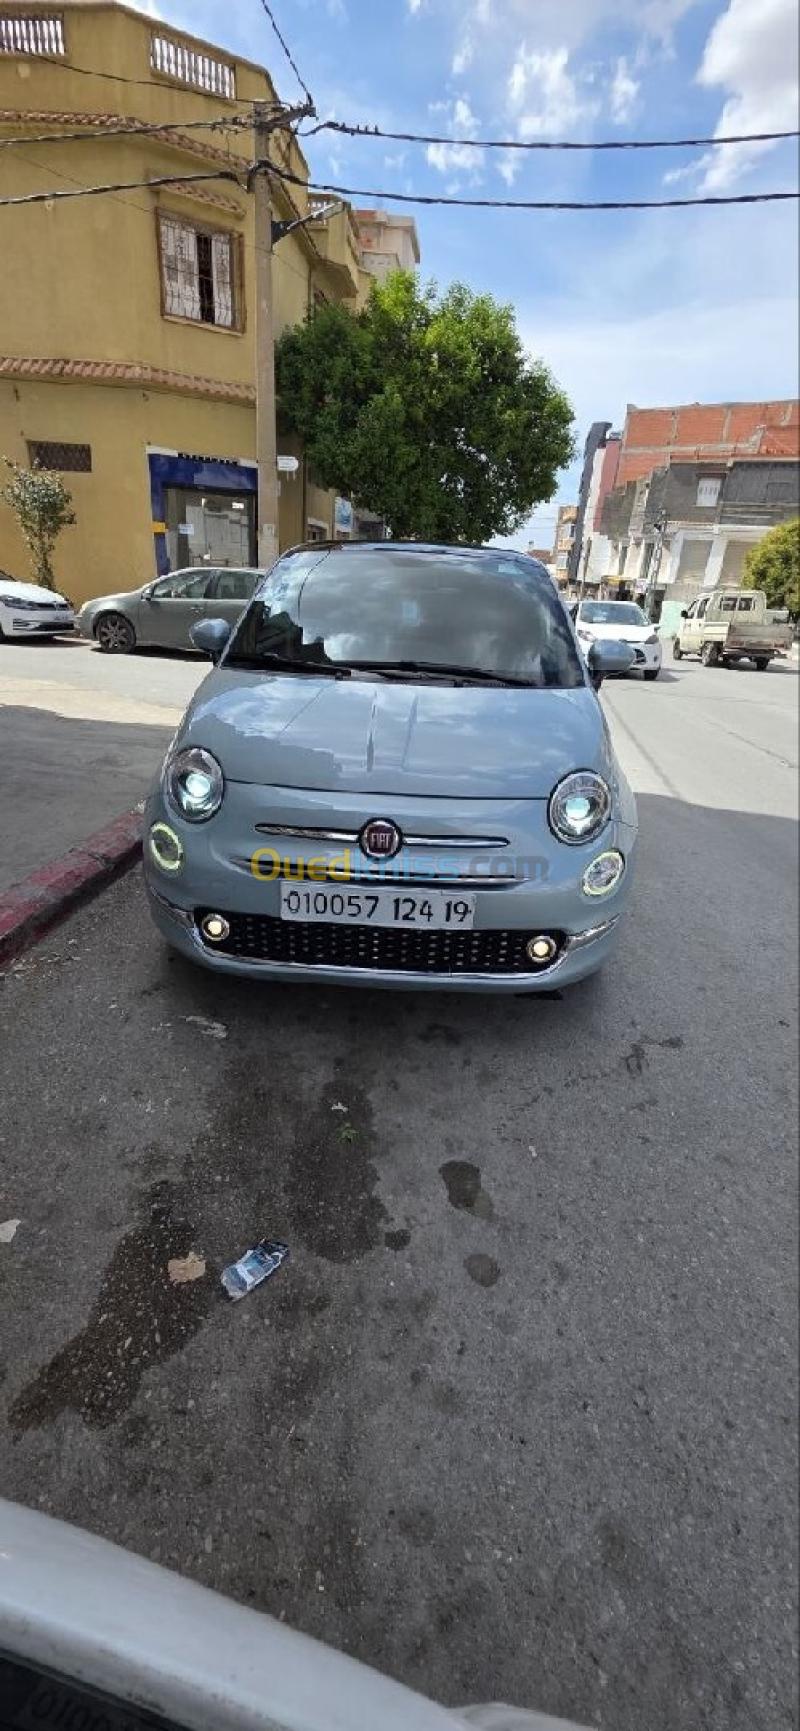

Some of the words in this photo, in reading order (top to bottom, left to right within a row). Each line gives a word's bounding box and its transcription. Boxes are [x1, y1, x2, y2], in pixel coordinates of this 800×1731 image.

[371, 833, 391, 849] FIAT
[287, 890, 380, 919] 010057
[393, 896, 433, 922] 124
[445, 900, 469, 922] 19
